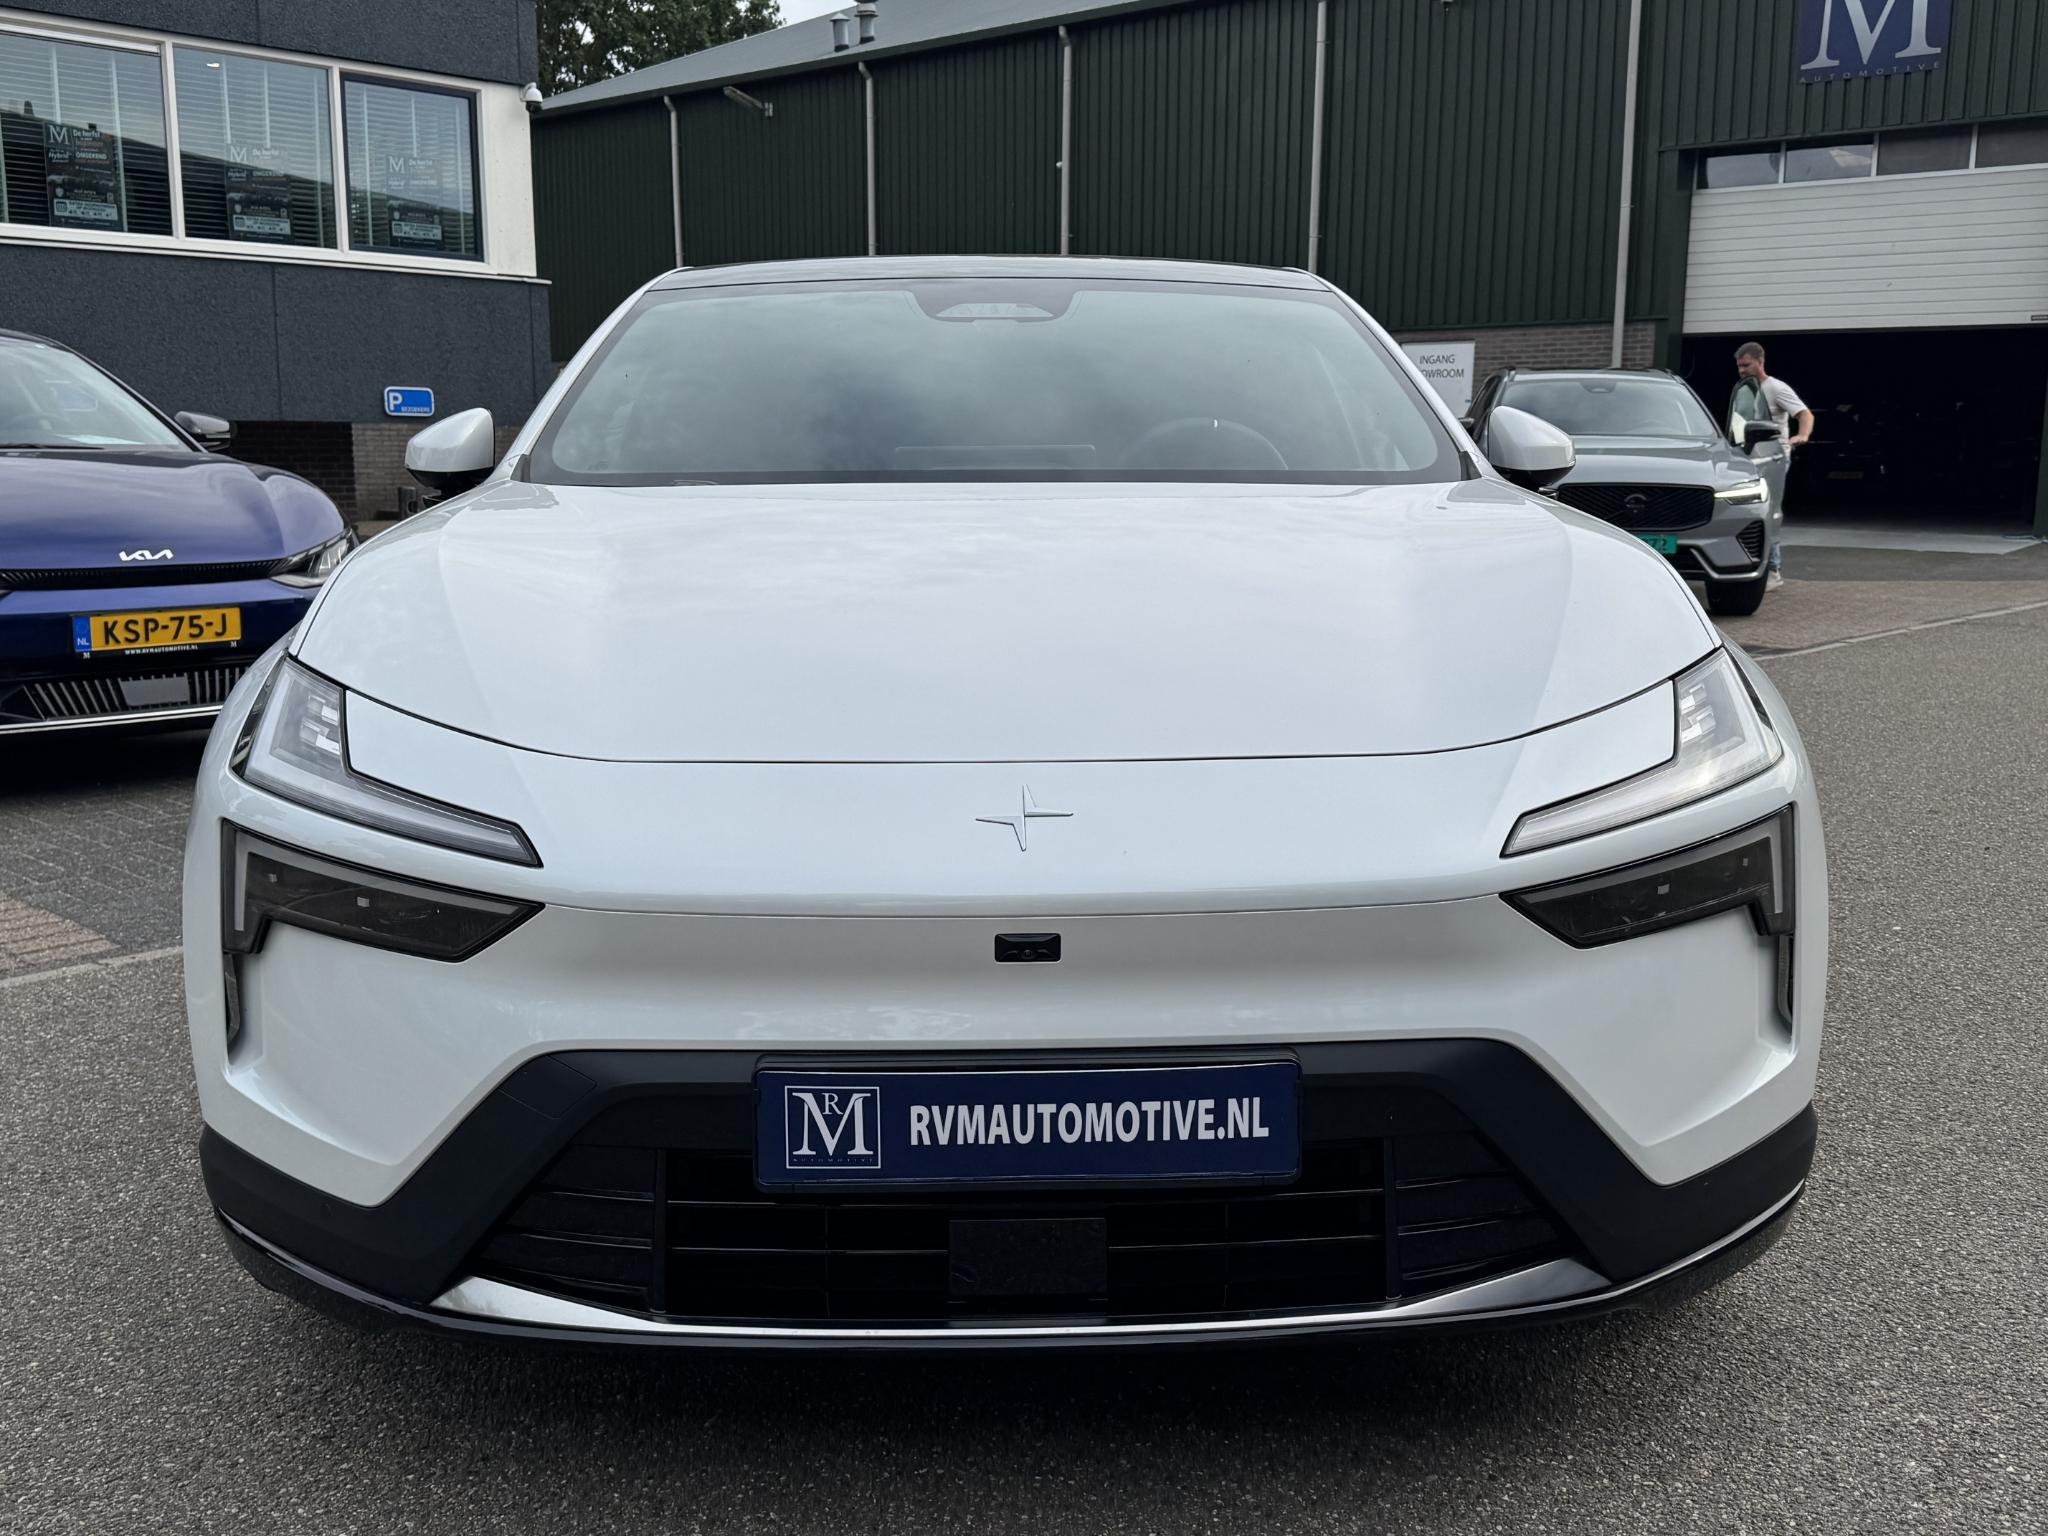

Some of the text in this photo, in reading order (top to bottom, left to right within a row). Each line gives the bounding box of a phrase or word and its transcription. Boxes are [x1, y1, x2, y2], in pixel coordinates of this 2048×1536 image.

[1799, 61, 1941, 84] AUTOMOTIVE
[1420, 354, 1456, 365] INGANG
[1421, 368, 1465, 378] OWROOM
[389, 391, 403, 411] P
[118, 549, 174, 562] KIA
[77, 612, 227, 647] NL KSP-75-J
[909, 1096, 1270, 1147] RVMAUTOMOTIVE.NL
